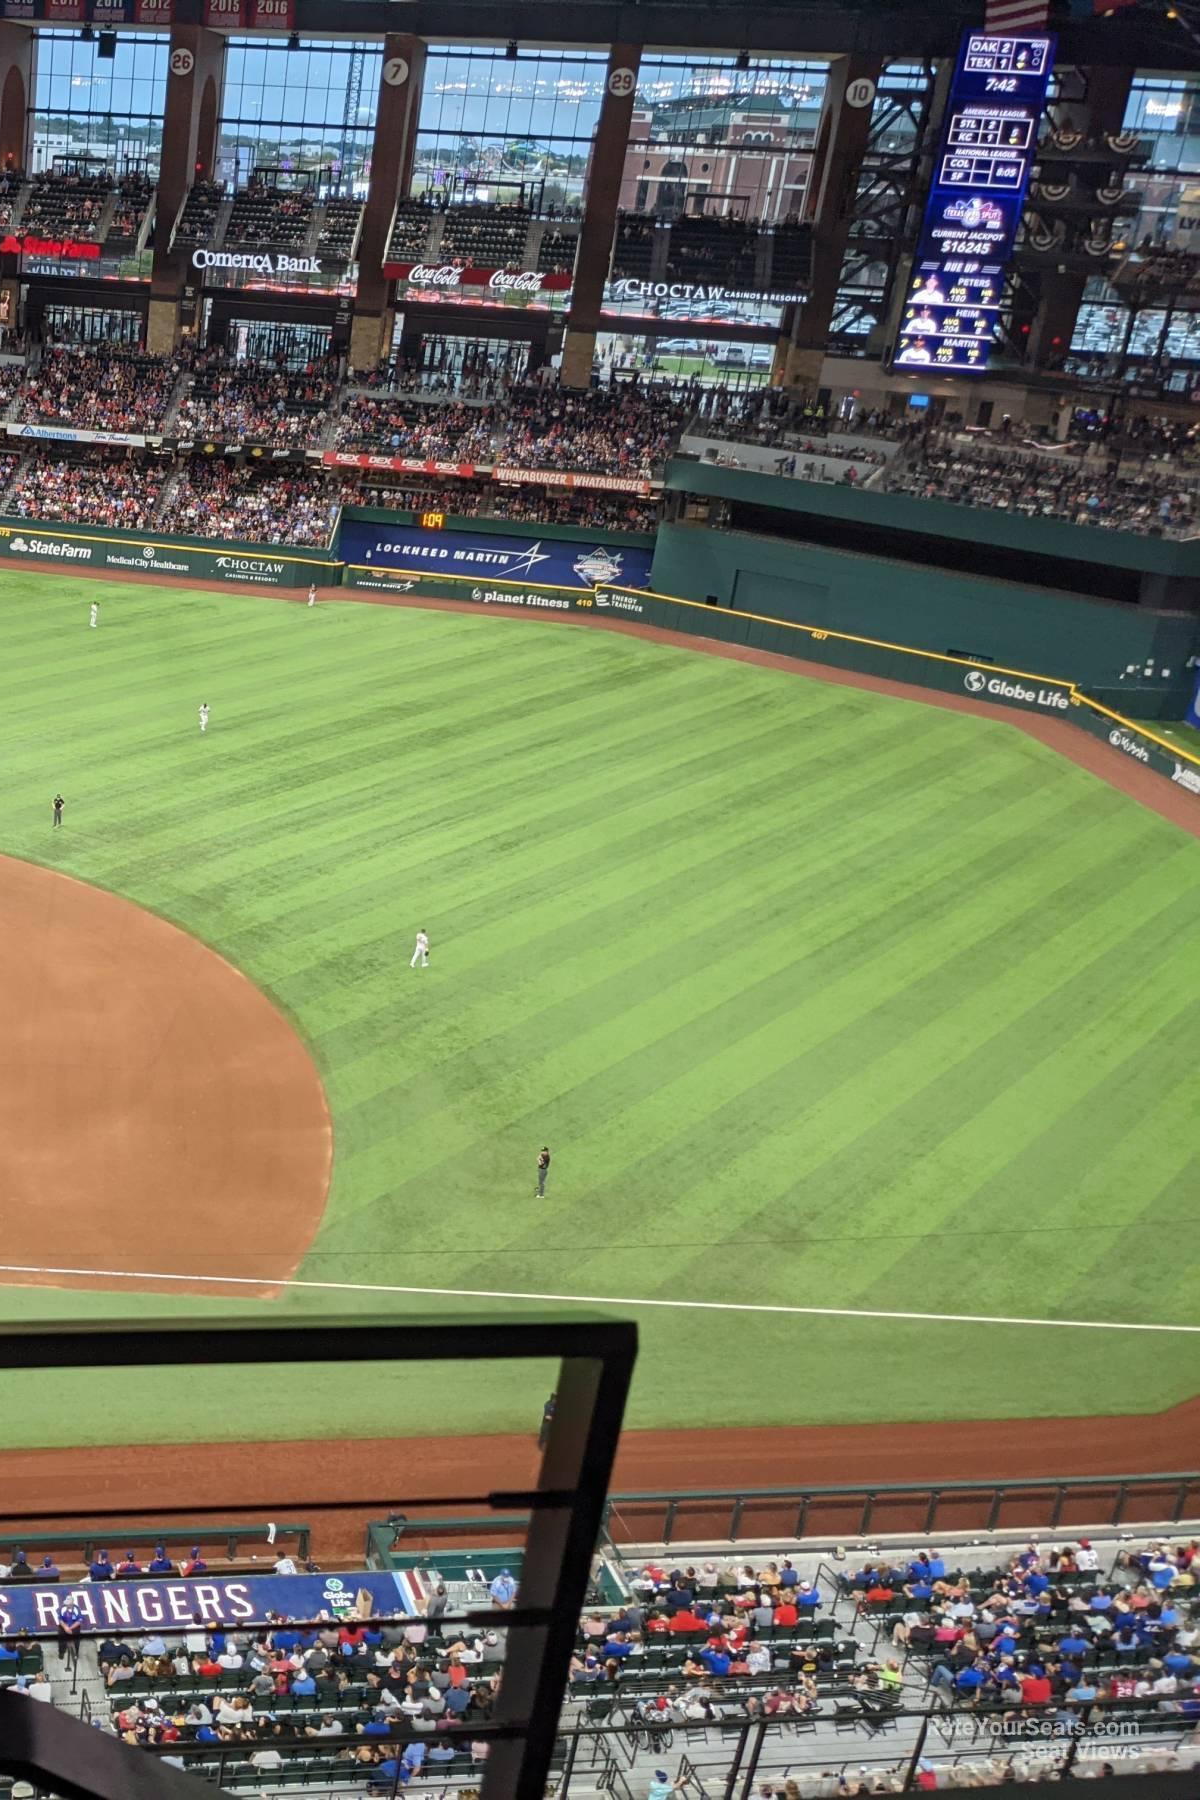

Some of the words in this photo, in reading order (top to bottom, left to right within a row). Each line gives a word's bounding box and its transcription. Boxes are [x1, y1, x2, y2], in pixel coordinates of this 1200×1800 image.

[210, 0, 239, 12] 2015
[257, 1, 287, 14] 2016
[971, 42, 997, 51] OAK
[1001, 43, 1010, 53] 2
[172, 56, 191, 70] 26
[970, 57, 992, 68] TEX
[1000, 59, 1006, 69] 1
[391, 65, 401, 78] 7
[612, 75, 632, 90] 29
[985, 78, 1017, 92] 7:42
[853, 85, 868, 100] 10
[962, 108, 998, 116] AMERICAN
[999, 110, 1027, 118] LEAGUE
[960, 119, 976, 128] STL
[988, 121, 996, 129] 2
[958, 133, 973, 141] KC
[955, 148, 988, 157] NATIONAL
[990, 150, 1017, 158] LEAGUE
[950, 159, 970, 168] COL
[951, 172, 964, 181] SF
[931, 230, 968, 239] CURRENT
[968, 232, 1005, 241] JACKPOT
[940, 240, 991, 255] $16245
[277, 254, 322, 273] Bank
[943, 262, 963, 272] DUE
[964, 262, 979, 273] UP
[957, 278, 991, 288] PETERS
[625, 279, 724, 300] CHOCTAW
[724, 291, 760, 300] CASINOS
[770, 294, 807, 303] RESORTS
[949, 287, 967, 295] AVG
[955, 309, 980, 318] HEIM
[943, 338, 978, 348] MARTIN
[36, 428, 78, 440] Albertsons
[108, 433, 131, 442] Thumb
[336, 453, 359, 462] DEX
[368, 456, 392, 465] DEX
[400, 460, 426, 468] DEX
[434, 462, 459, 471] DEX
[497, 468, 568, 485] WHATABURGER
[573, 475, 645, 491] WHATABURGER
[422, 513, 442, 527] 1:09
[376, 543, 448, 559] LOCKHEED
[453, 551, 509, 564] MARTIN
[106, 555, 134, 566] Medical
[134, 559, 150, 569] City
[150, 560, 189, 571] Healthcare
[222, 557, 284, 573] CHOCTAW
[484, 591, 524, 604] planet
[526, 594, 570, 609] fitness
[576, 599, 593, 607] 410
[612, 594, 637, 604] ENERGY
[611, 601, 643, 613] TRANSFER
[988, 679, 1035, 701] Globe
[1037, 689, 1069, 709] Life
[323, 1591, 354, 1600] Globe
[330, 1598, 351, 1608] Life
